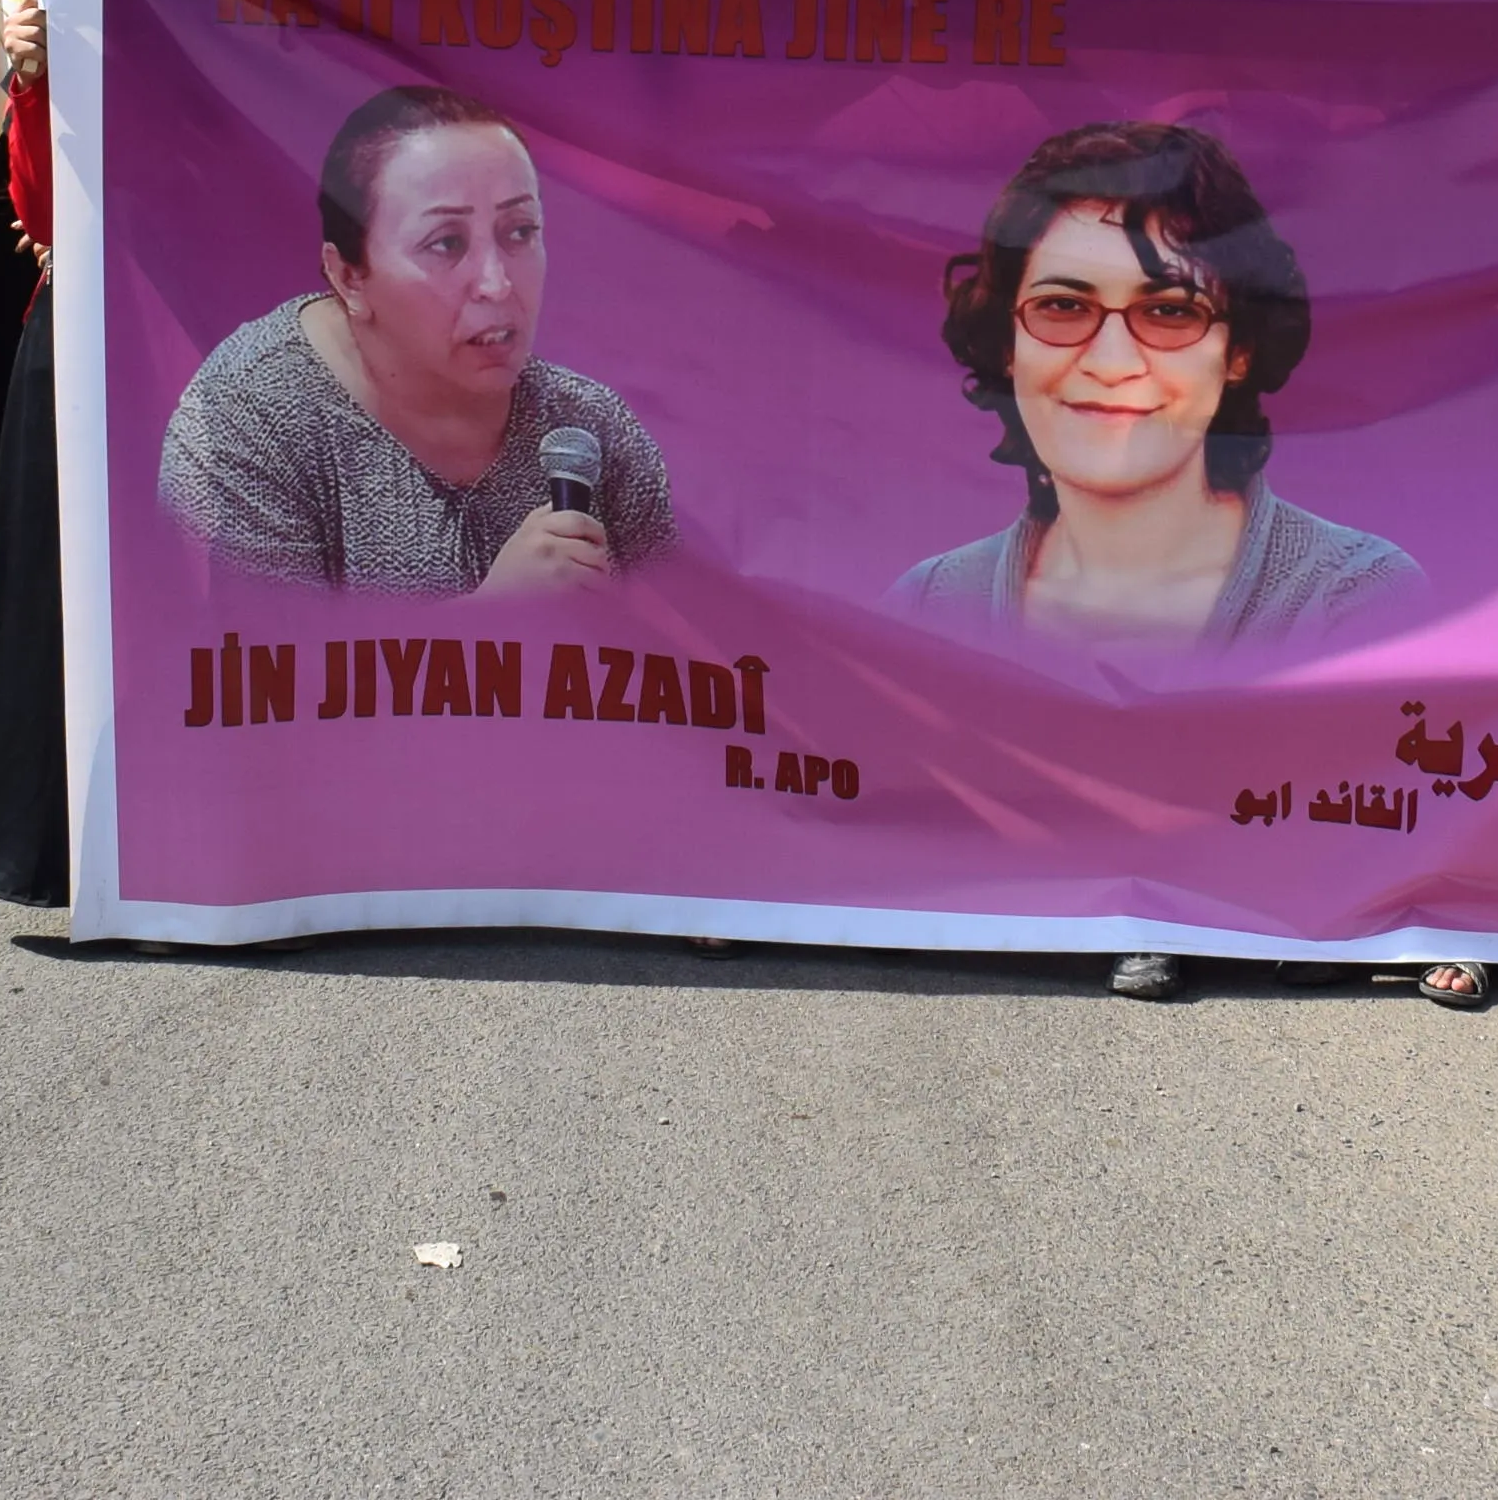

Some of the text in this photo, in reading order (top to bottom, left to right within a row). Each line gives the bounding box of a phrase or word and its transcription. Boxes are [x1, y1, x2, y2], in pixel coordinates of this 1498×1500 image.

[318, 638, 521, 718] JIYAN
[543, 643, 770, 735] AZADÎ
[774, 751, 860, 800] APO
